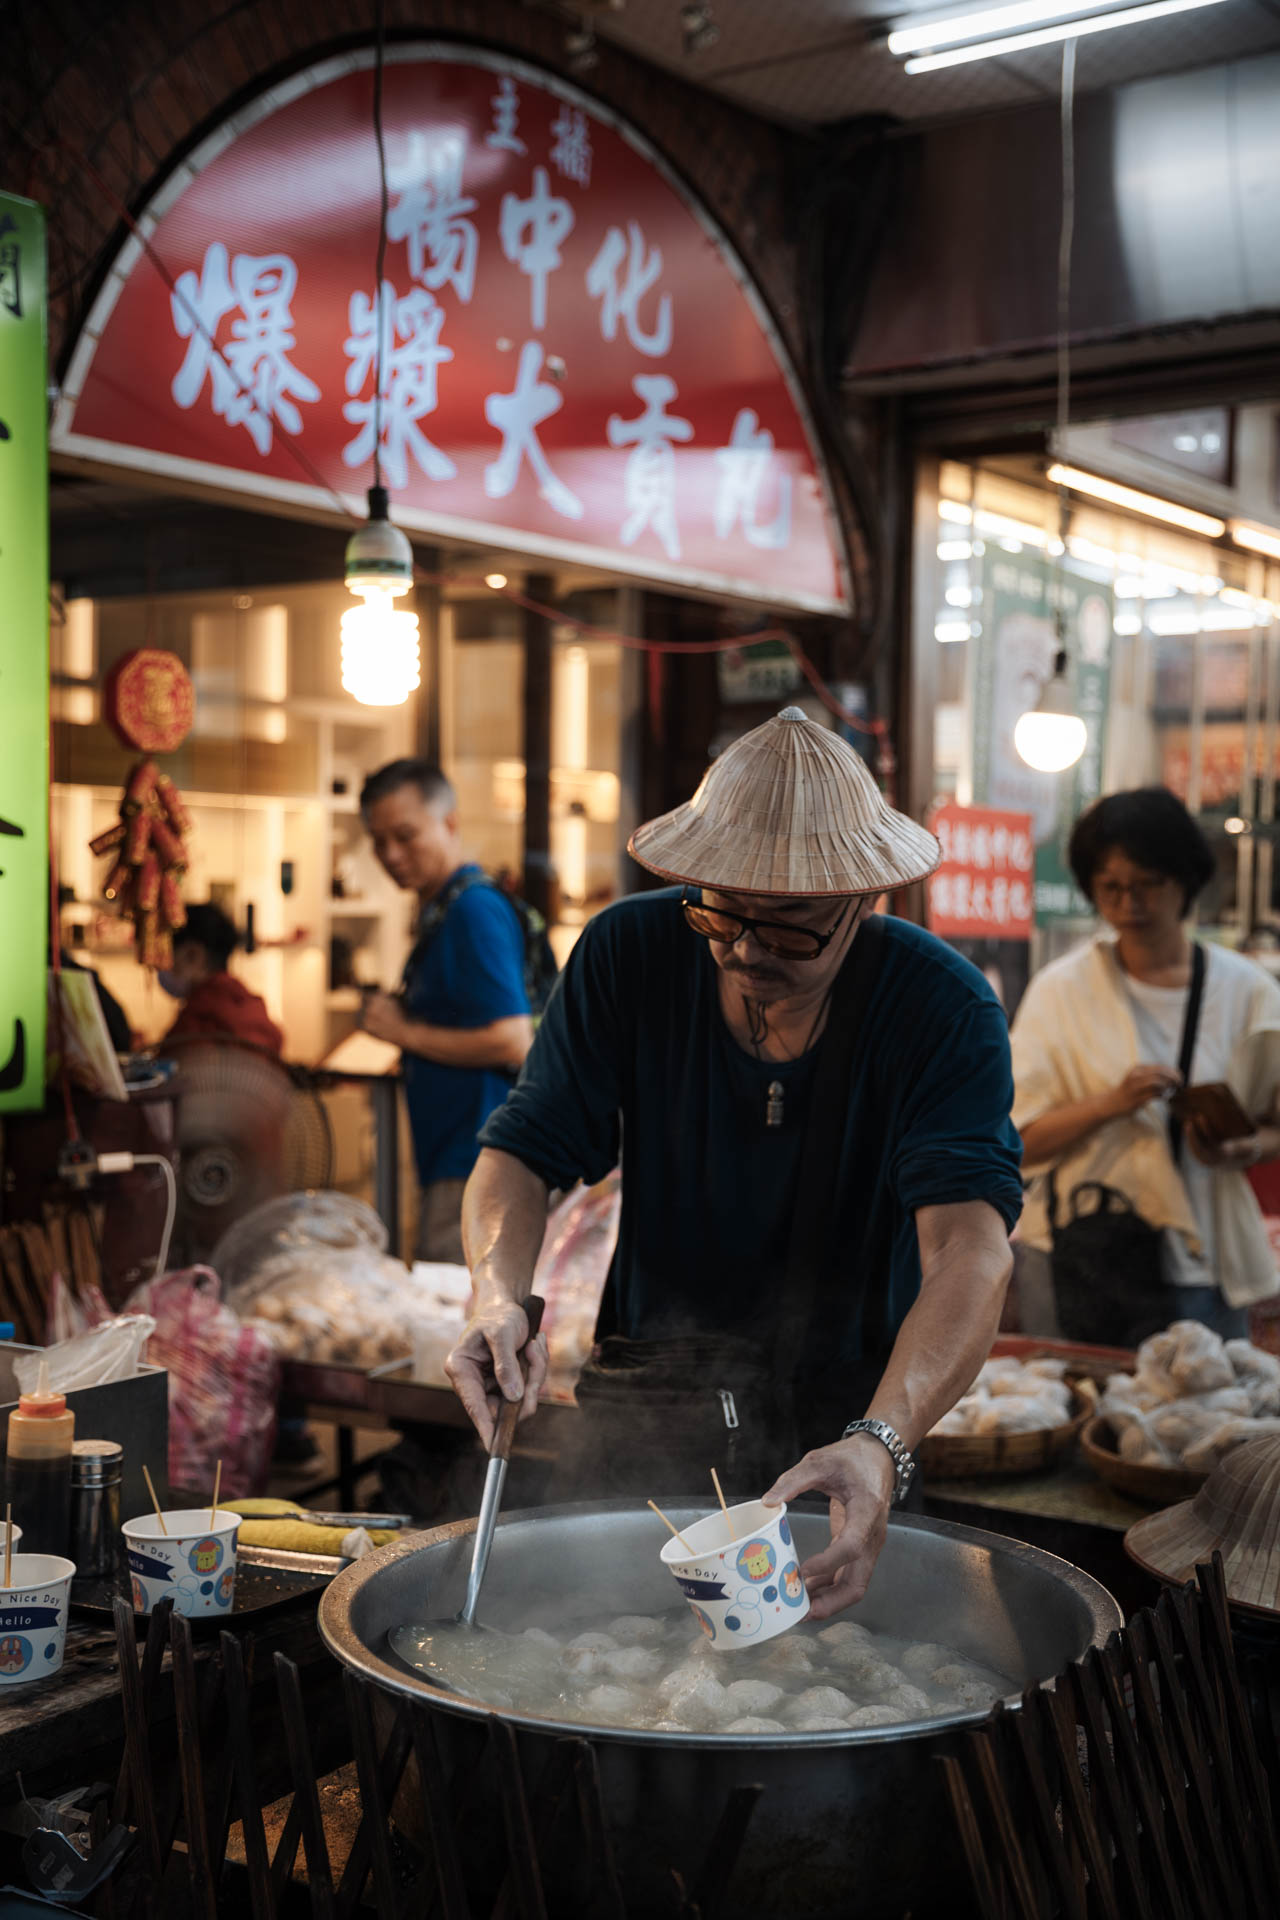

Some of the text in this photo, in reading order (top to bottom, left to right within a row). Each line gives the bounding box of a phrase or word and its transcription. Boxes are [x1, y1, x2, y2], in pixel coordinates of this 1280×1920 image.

[150, 1546, 171, 1562] Day
[694, 1568, 718, 1581] Day
[9, 1594, 60, 1607] Nice Day
